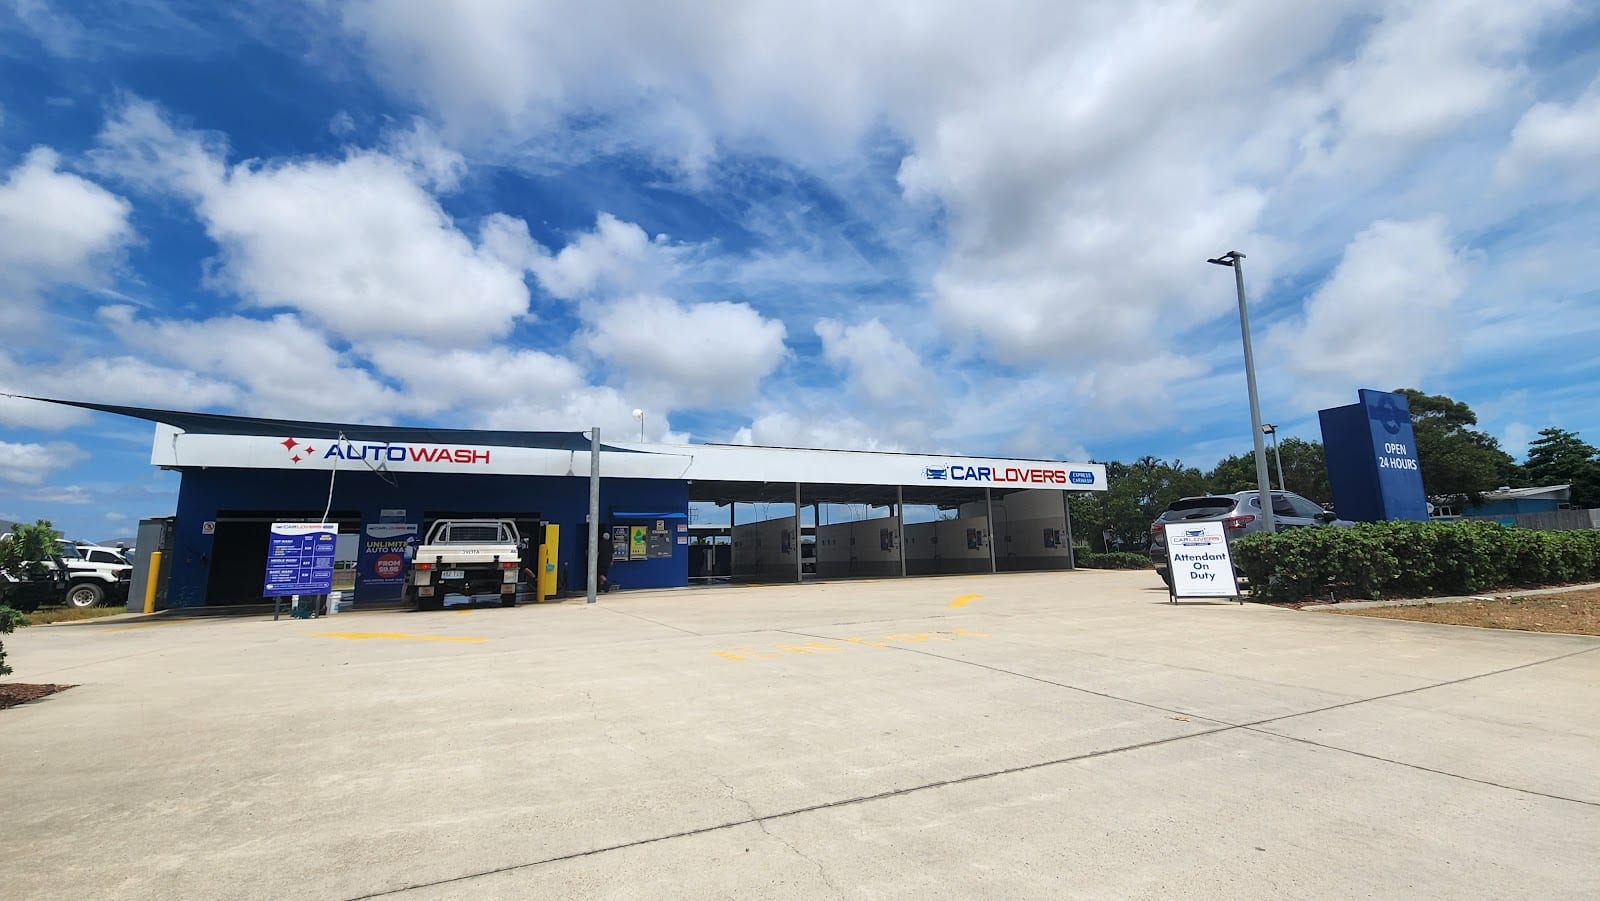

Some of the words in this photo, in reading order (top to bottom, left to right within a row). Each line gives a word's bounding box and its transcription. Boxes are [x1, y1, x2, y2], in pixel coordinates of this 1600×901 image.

[323, 443, 491, 465] AUTOWASH
[1384, 442, 1407, 455] OPEN
[1379, 456, 1389, 468] 24
[1390, 457, 1417, 470] HOURS
[950, 465, 1067, 484] CARLOVERS
[1174, 552, 1226, 562] Attendant
[1193, 562, 1209, 570] On
[1190, 571, 1216, 582] Duty
